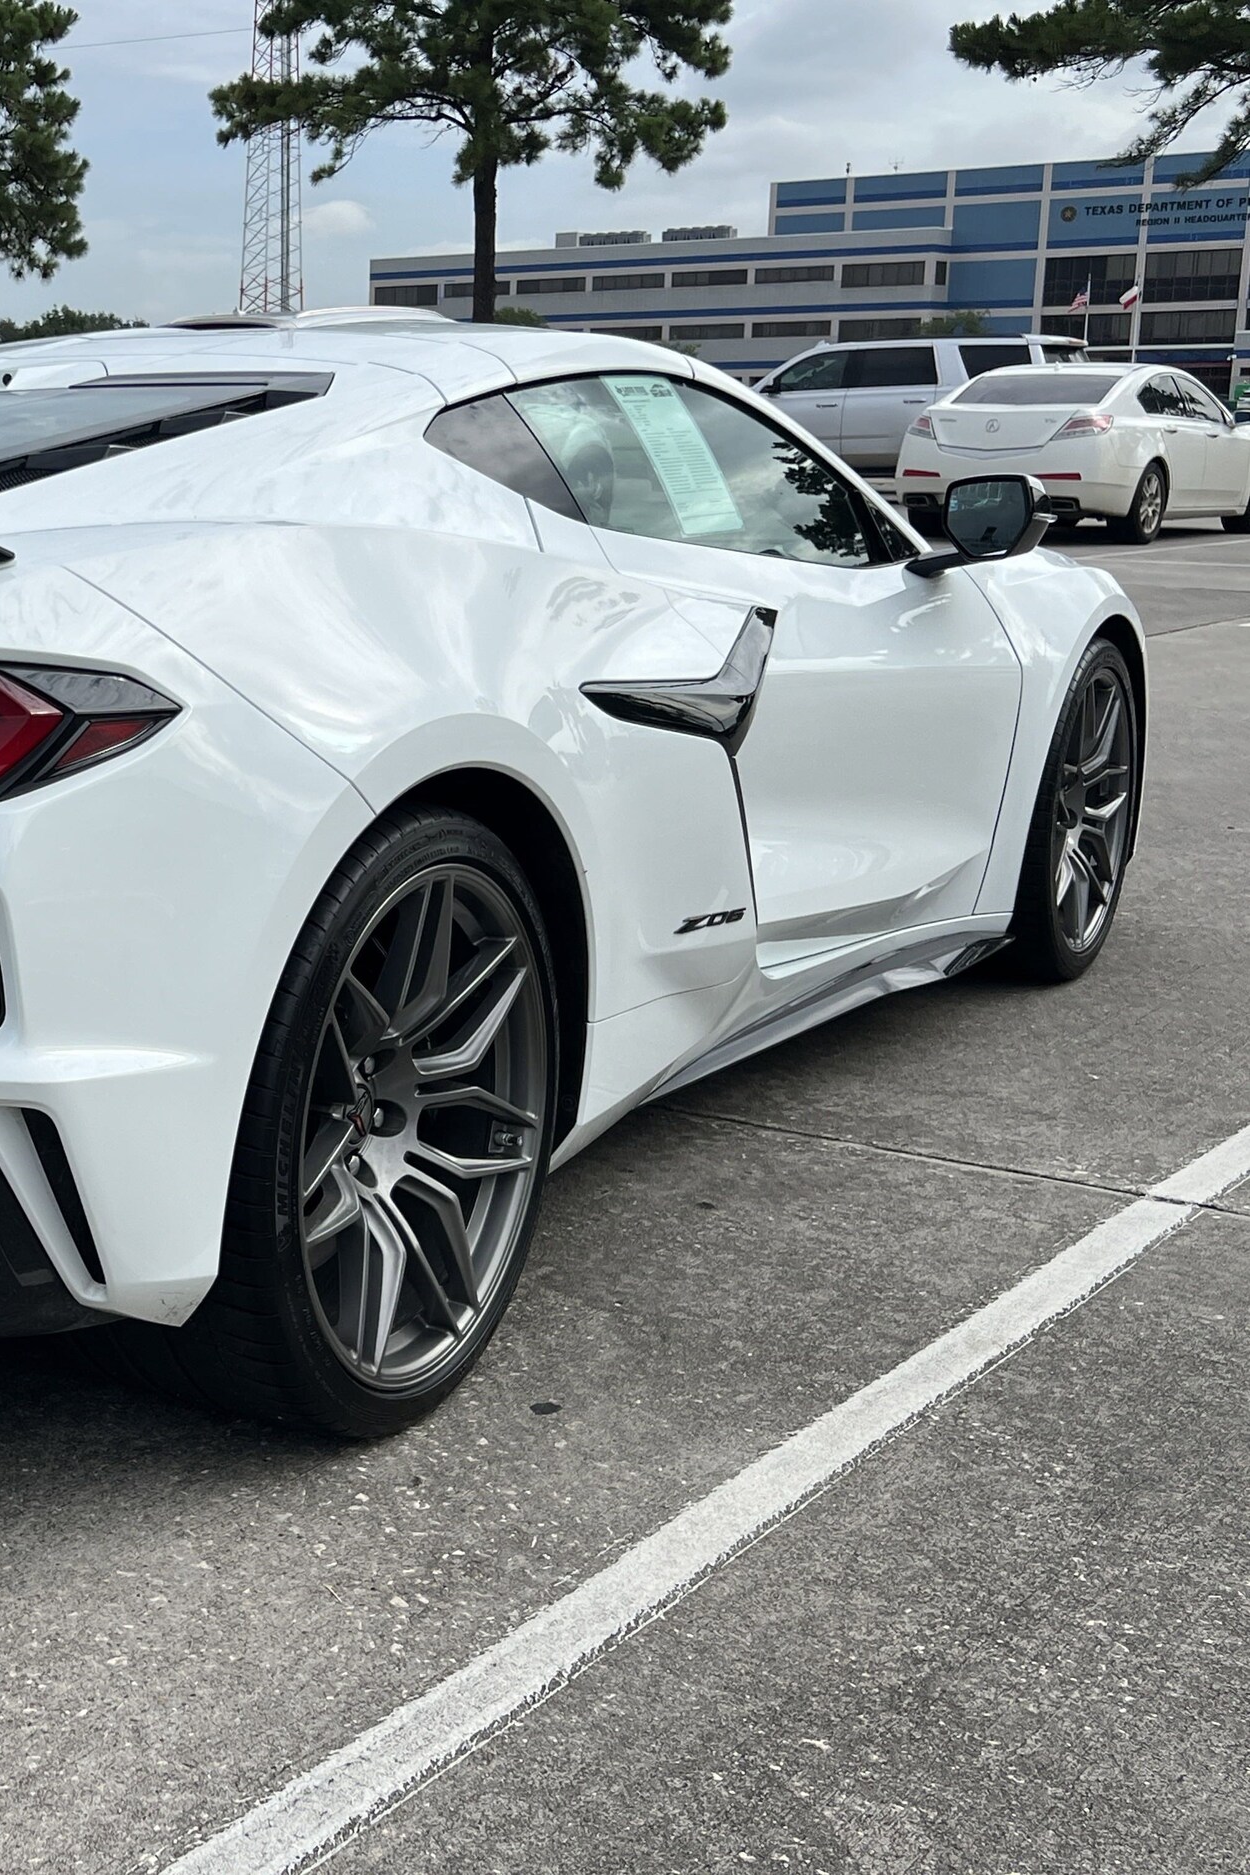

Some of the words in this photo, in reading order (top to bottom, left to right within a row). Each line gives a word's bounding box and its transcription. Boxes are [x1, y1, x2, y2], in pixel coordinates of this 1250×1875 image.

[1085, 204, 1124, 216] TEXAS
[1128, 199, 1212, 214] DEPARTMENT
[1216, 198, 1234, 208] OF
[1135, 216, 1169, 227] REGION
[673, 906, 747, 934] Z06
[277, 1066, 302, 1217] MICHELIN
